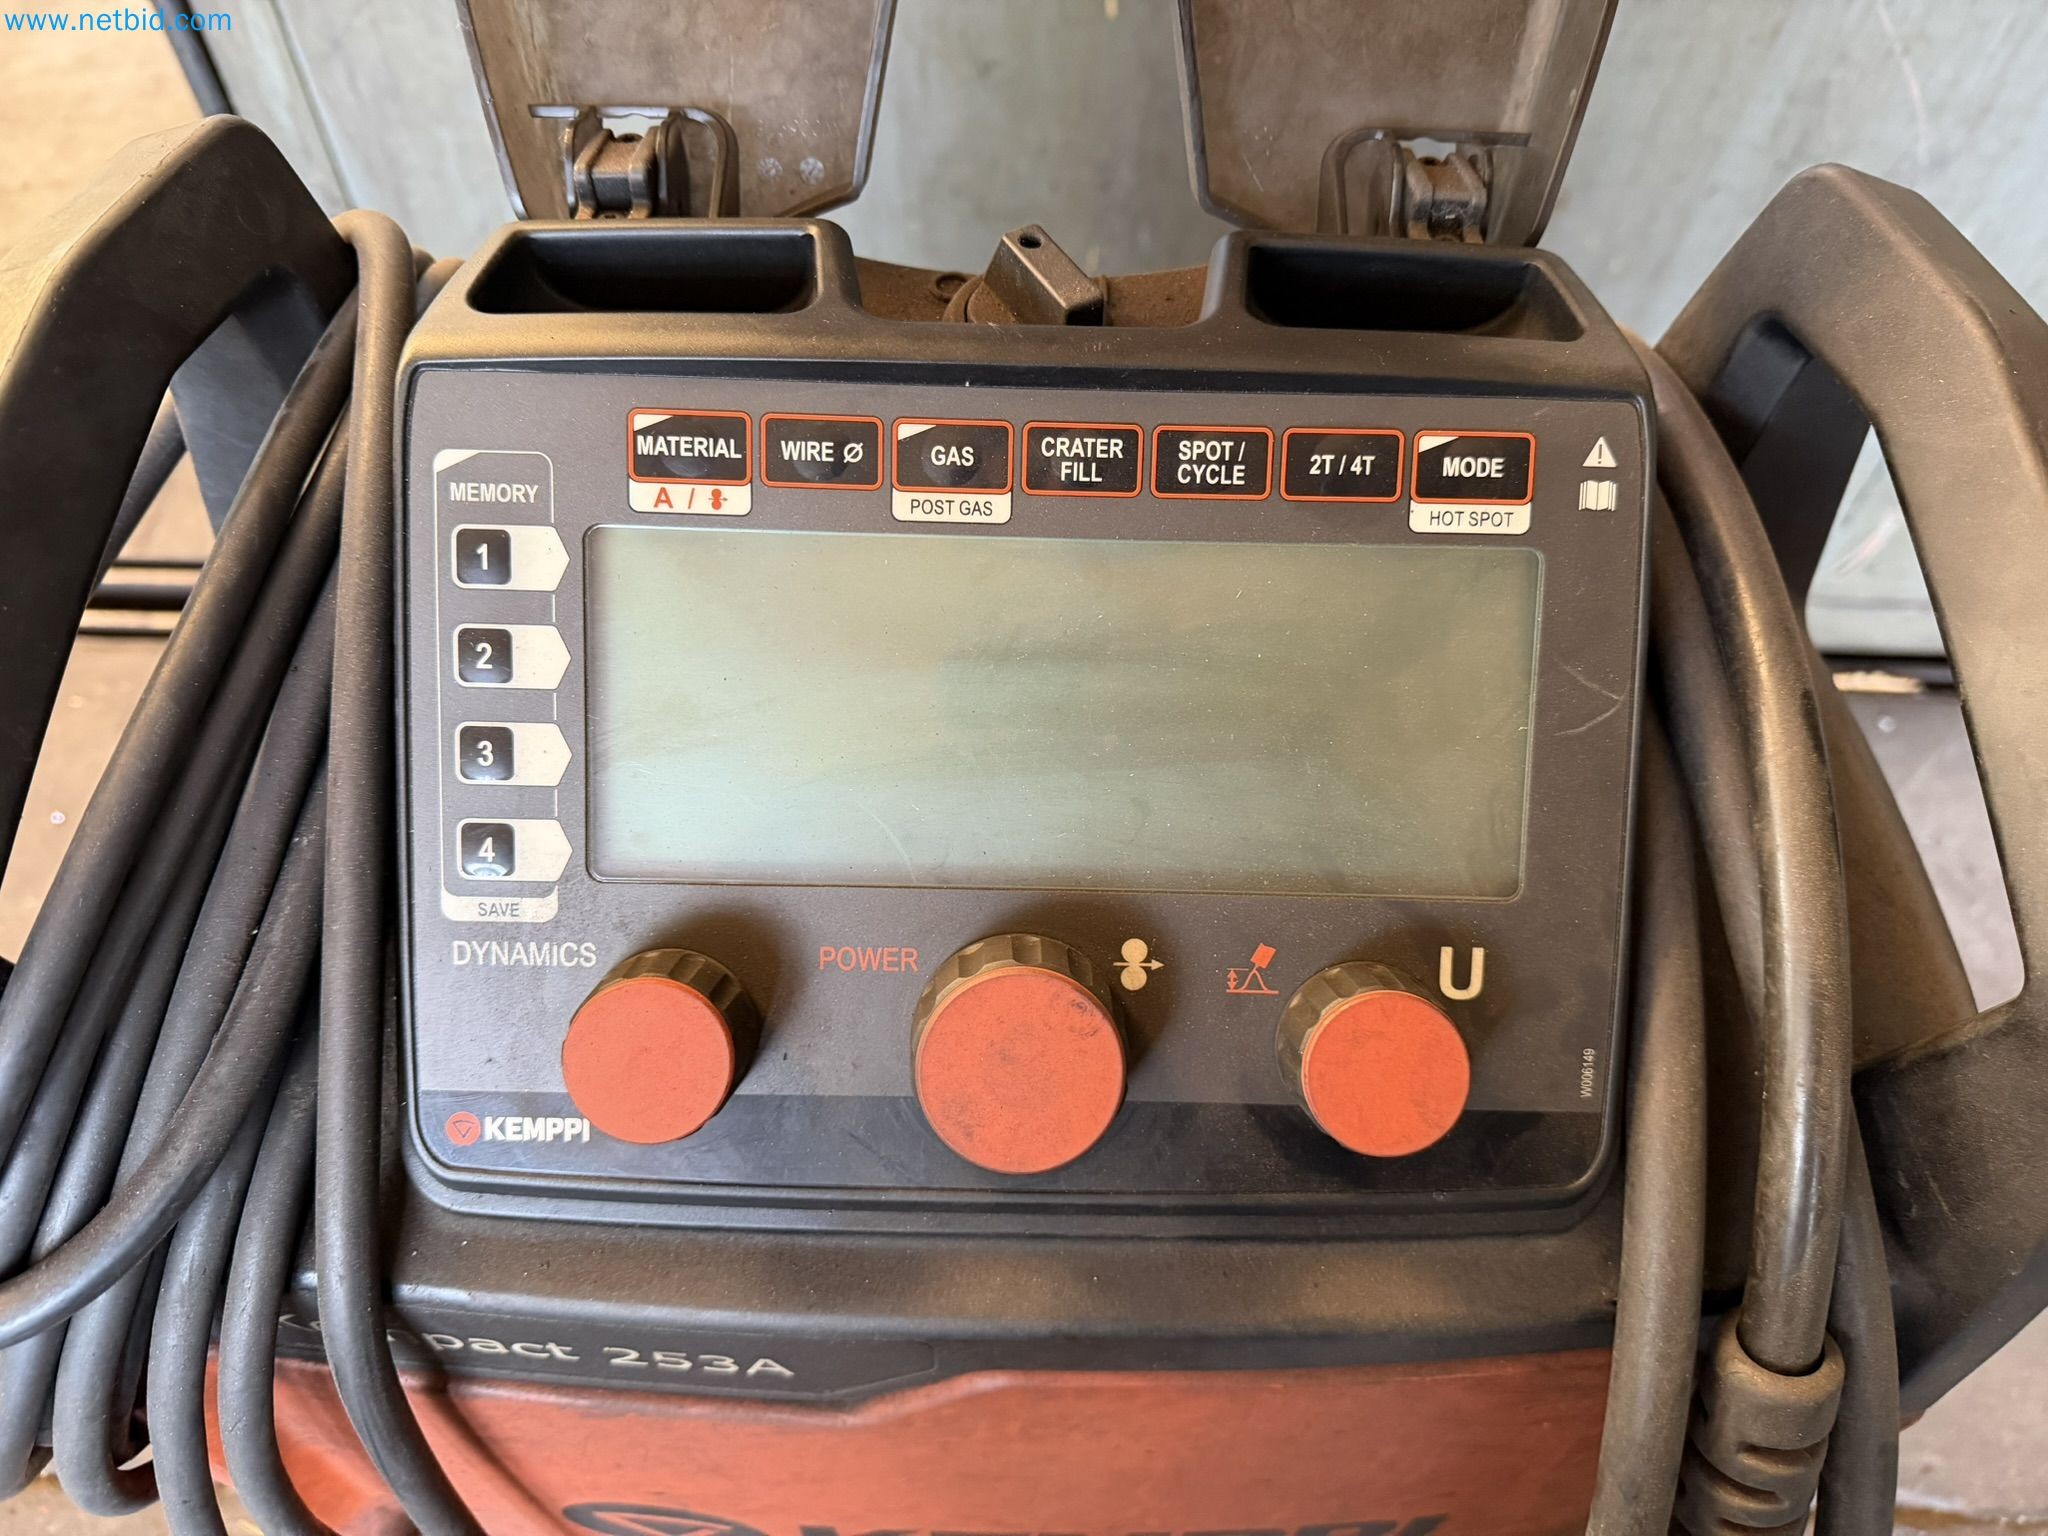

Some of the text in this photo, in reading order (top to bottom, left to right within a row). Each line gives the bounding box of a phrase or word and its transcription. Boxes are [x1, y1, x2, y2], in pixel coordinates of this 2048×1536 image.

[636, 434, 742, 460] MATERIAL
[781, 440, 834, 462] WIRE
[930, 446, 974, 467] GAS
[1041, 437, 1123, 460] CRATER
[1178, 440, 1234, 463] SPOT
[1060, 461, 1103, 483] FILL
[1177, 464, 1246, 487] CYCLE
[1309, 454, 1335, 475] 2T
[1350, 455, 1376, 477] 4T
[1442, 457, 1504, 479] MODE
[450, 482, 539, 503] MEMORY
[653, 487, 673, 509] A
[909, 499, 993, 518] POST GAS
[1430, 510, 1514, 528] HOT SPOT
[476, 543, 488, 570] 1
[475, 642, 493, 669] 2
[476, 740, 494, 767] 3
[478, 836, 495, 863] 4
[478, 902, 520, 917] SAVE
[451, 940, 597, 967] DYNAMICS
[818, 946, 919, 972] POWER
[1439, 946, 1485, 1000] U
[1580, 1048, 1595, 1098] W006149
[484, 1116, 591, 1143] KEMPPI
[602, 1346, 796, 1378] 253A
